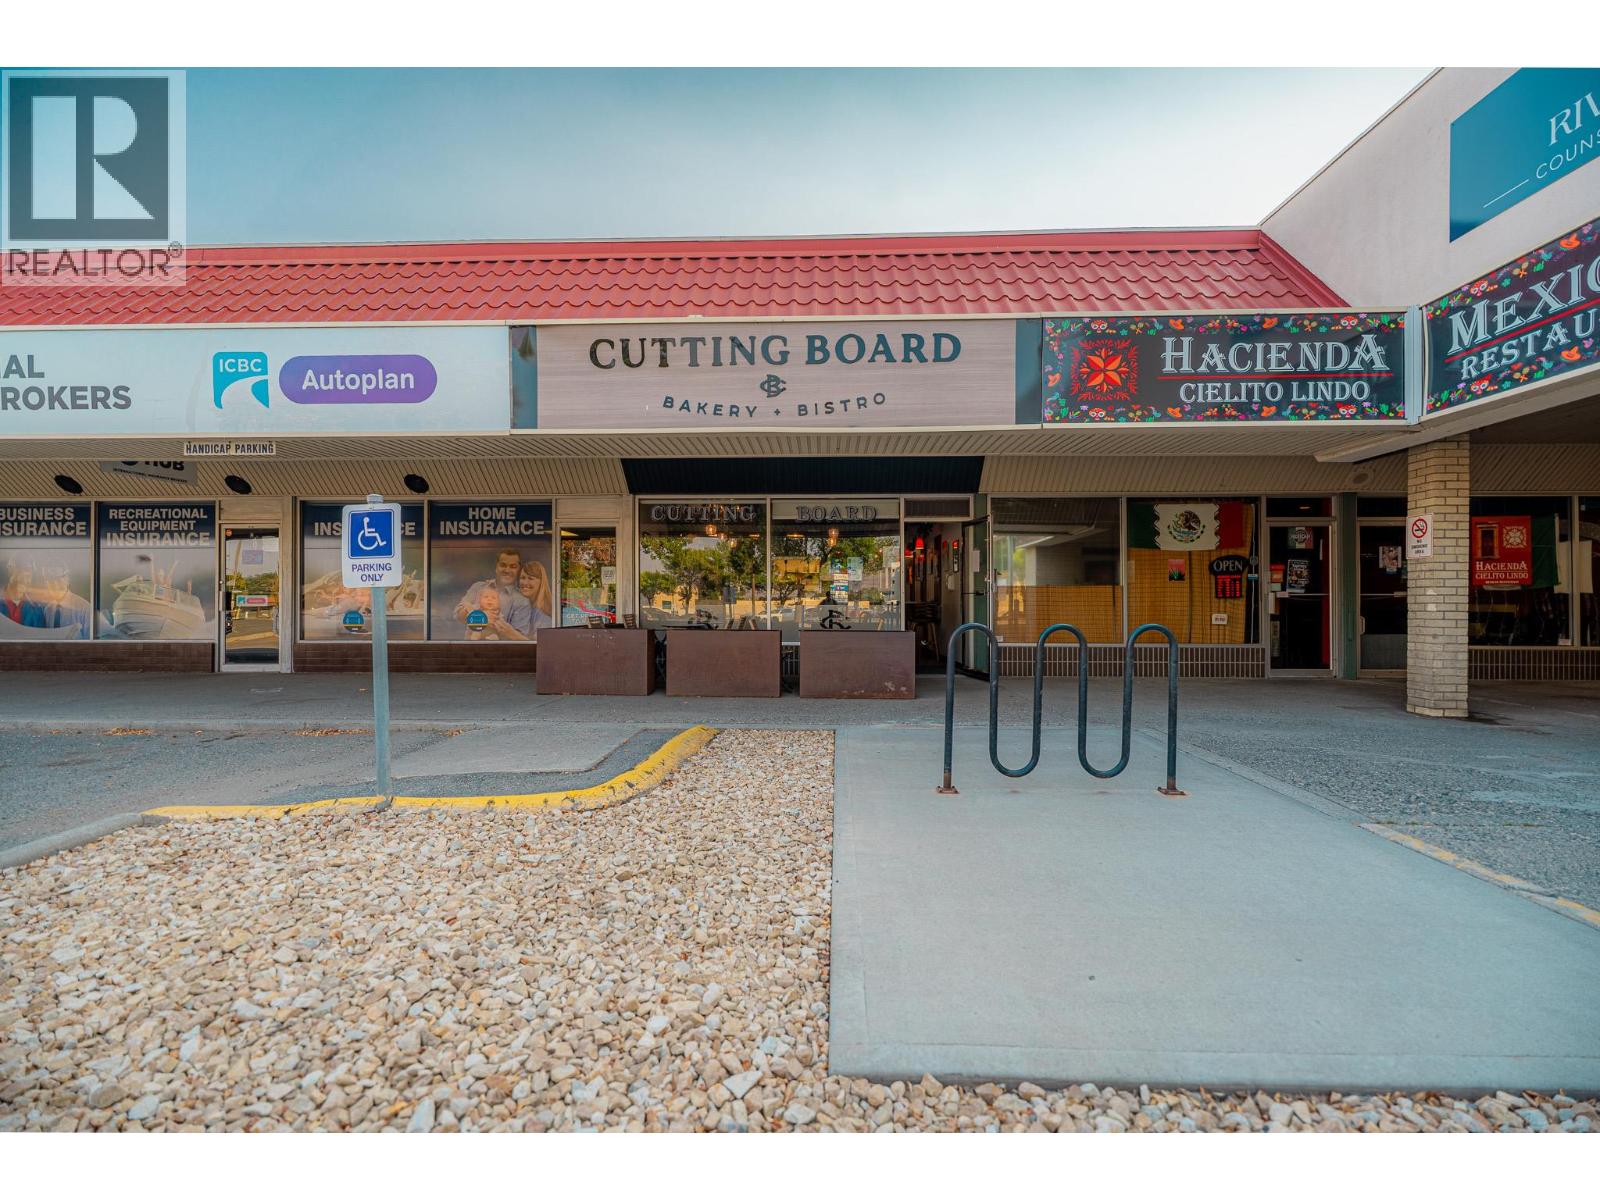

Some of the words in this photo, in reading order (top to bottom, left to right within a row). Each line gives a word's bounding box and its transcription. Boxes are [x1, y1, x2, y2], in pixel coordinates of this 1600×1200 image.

[1536, 128, 1600, 179] COUN
[589, 335, 790, 368] CUTTING
[805, 333, 962, 365] BOARD
[1460, 308, 1600, 380] RESTAU
[0, 354, 45, 378] AL
[219, 358, 262, 373] ICBC
[302, 368, 415, 395] Autoplan
[0, 385, 132, 410] ROKERS
[1179, 382, 1284, 403] CIELITO
[1291, 380, 1371, 402] LINDO
[662, 396, 758, 419] BAKERY
[798, 392, 887, 417] BISTRO
[186, 443, 231, 454] HANDICAP
[235, 443, 274, 454] PARKING
[109, 508, 208, 520] RECREATIONAL
[468, 507, 516, 520] HOME
[650, 504, 756, 522] CUTTING
[796, 504, 877, 522] BOARD
[0, 521, 86, 536] SURANCE
[120, 520, 196, 531] EQUIPMENT
[440, 520, 545, 536] INSURANCE
[106, 532, 210, 547] INSURANCE
[351, 562, 392, 573] PARKING
[1213, 560, 1243, 571] OPEN
[360, 574, 384, 582] ONLY
